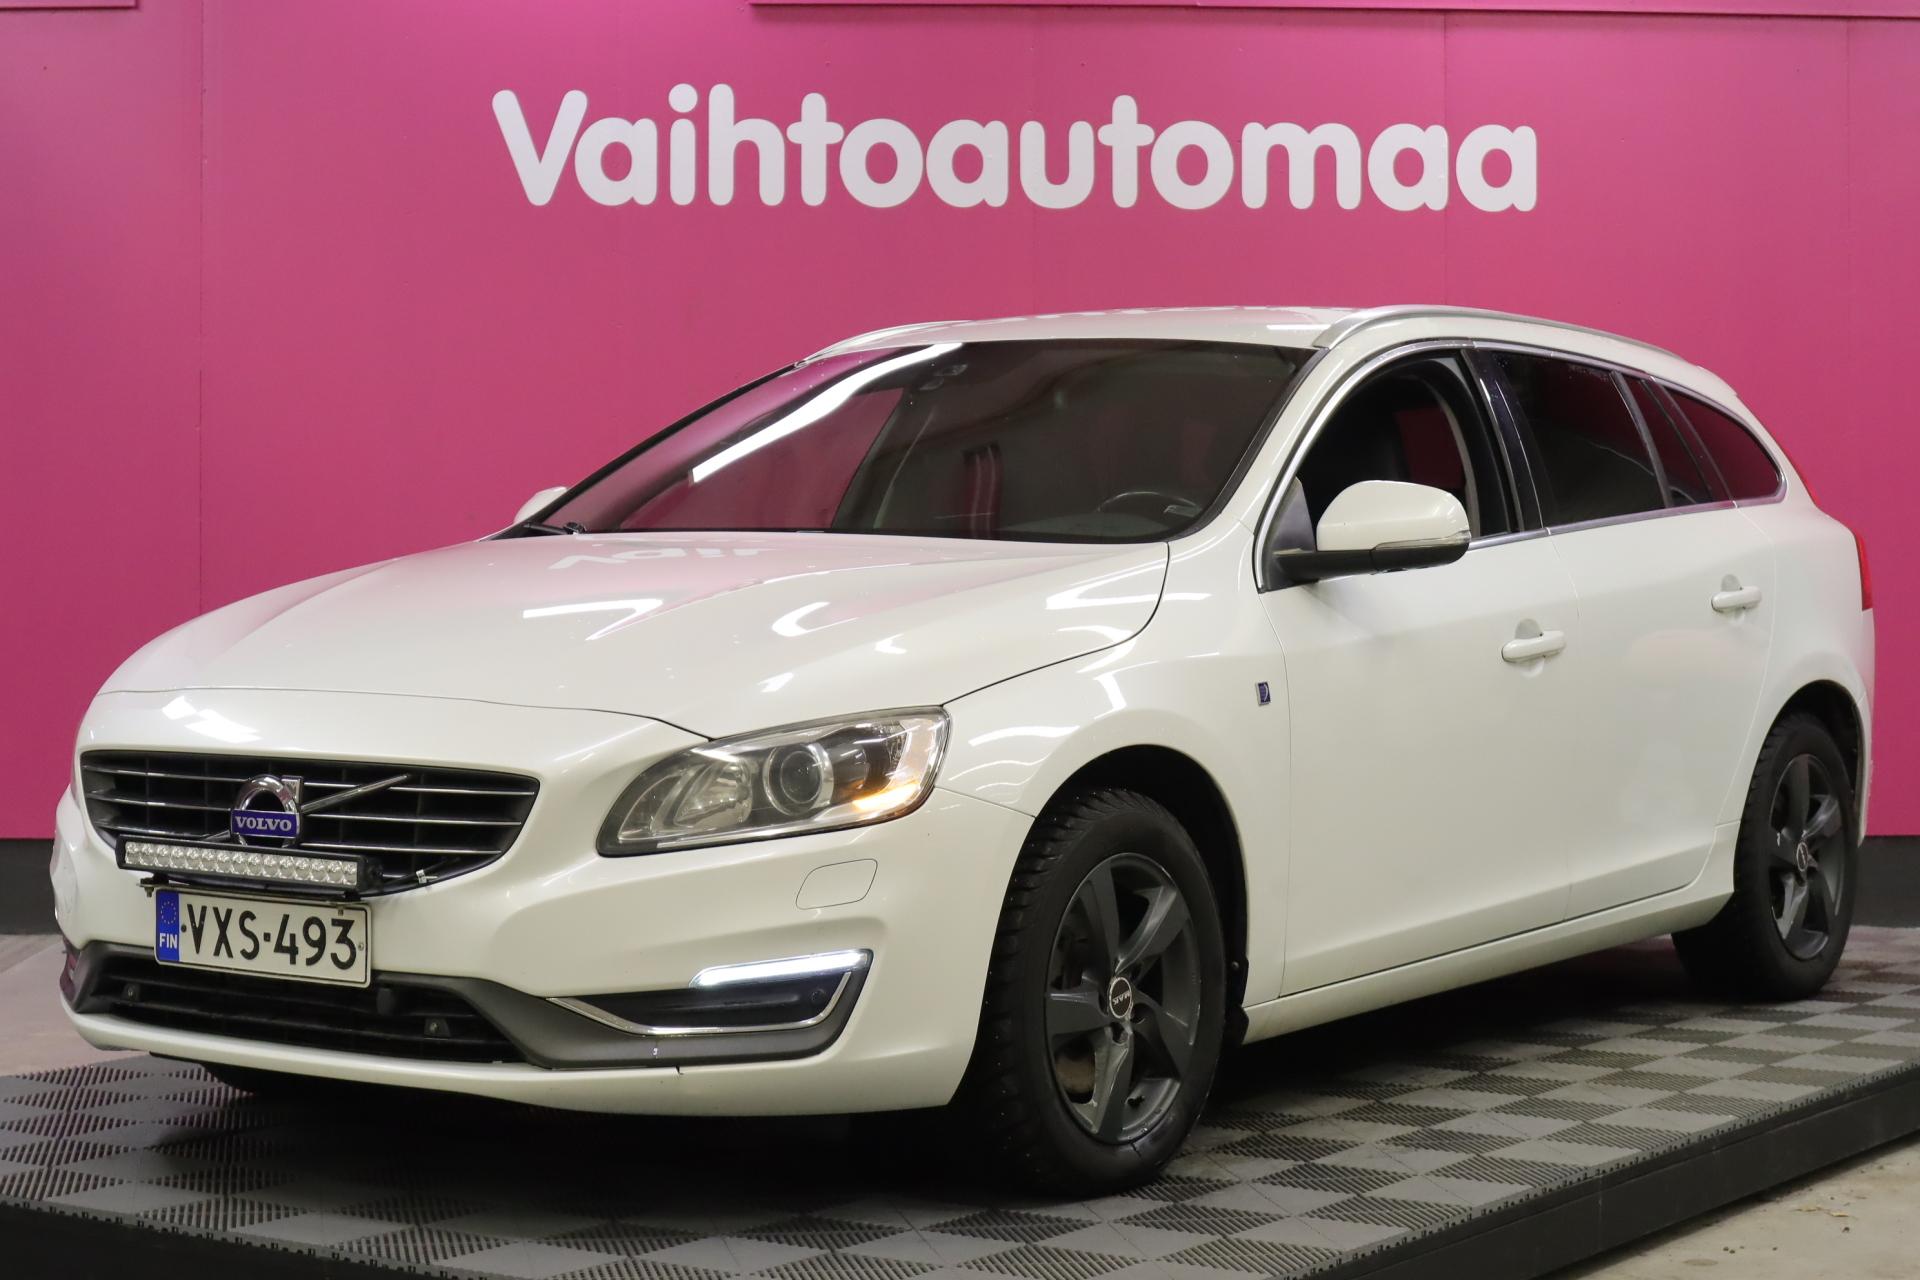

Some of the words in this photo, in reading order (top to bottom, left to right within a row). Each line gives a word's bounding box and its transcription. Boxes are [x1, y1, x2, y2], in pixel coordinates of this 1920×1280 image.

[491, 83, 1538, 212] Vaihtoautomaa
[235, 815, 292, 832] VOLVO
[158, 932, 178, 950] FIN
[186, 903, 357, 970] VXS-493
